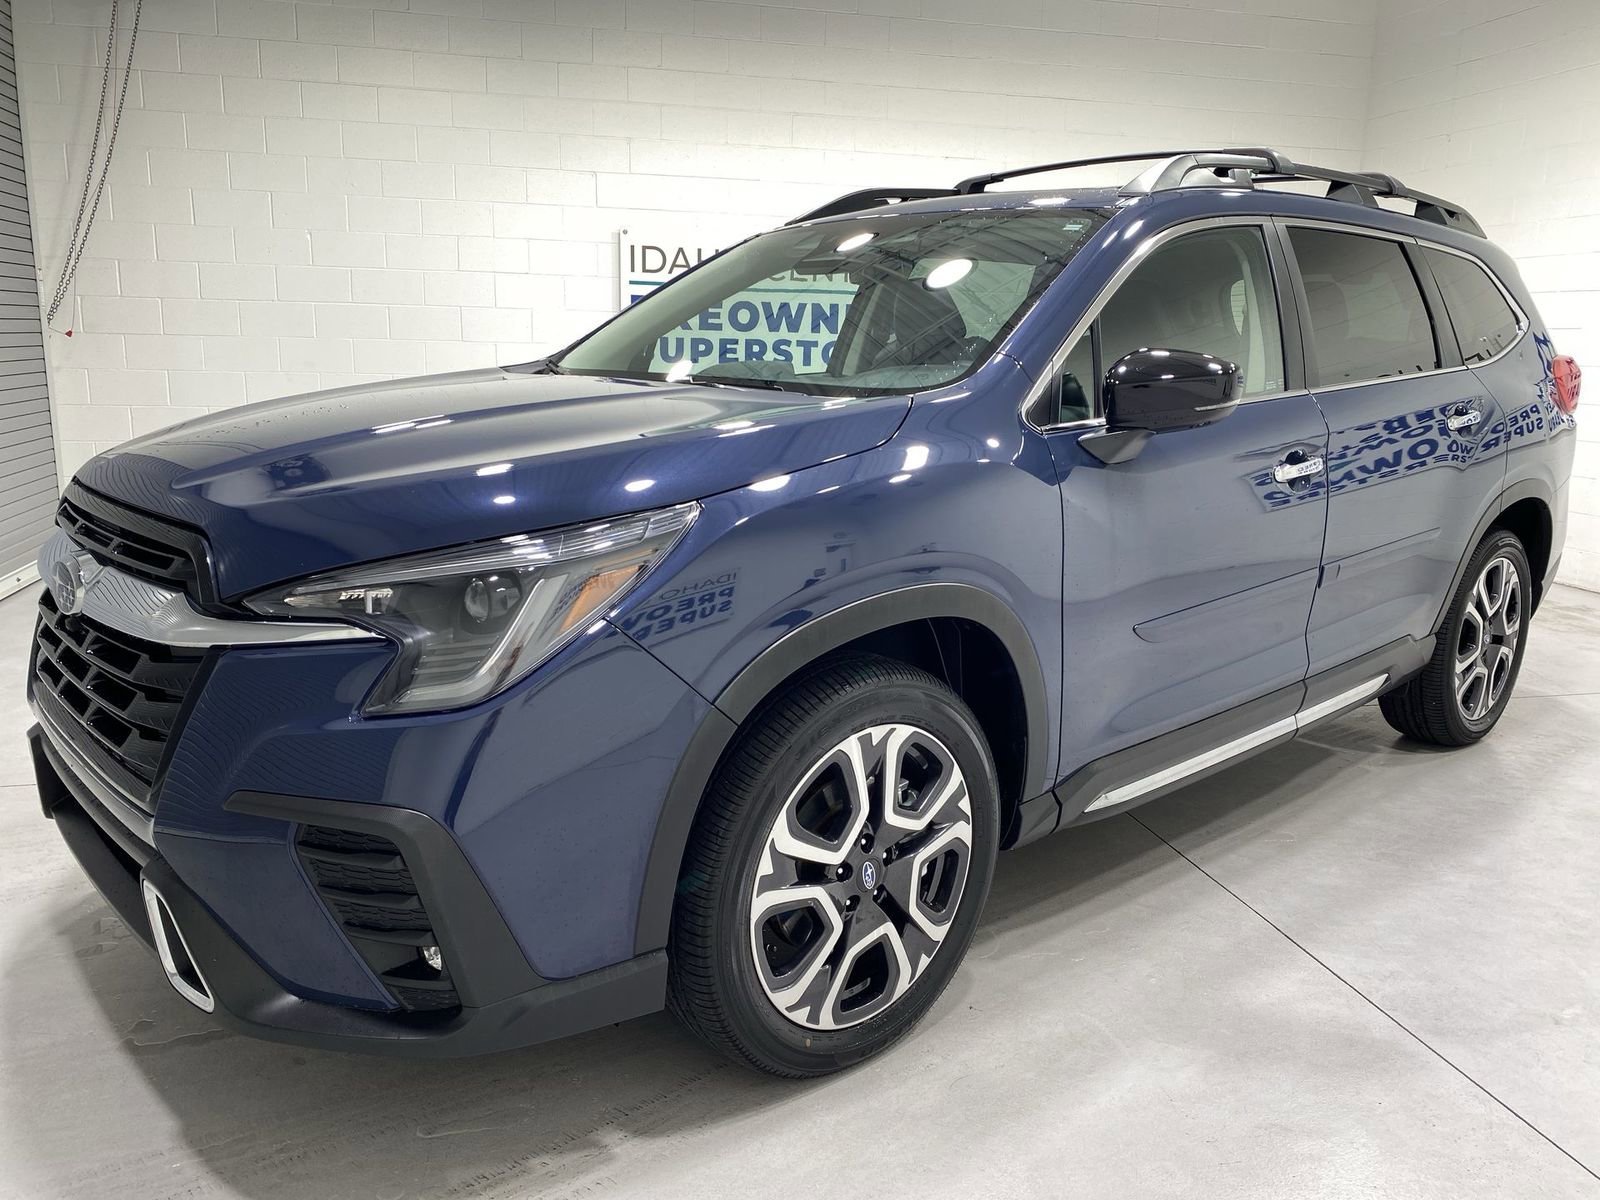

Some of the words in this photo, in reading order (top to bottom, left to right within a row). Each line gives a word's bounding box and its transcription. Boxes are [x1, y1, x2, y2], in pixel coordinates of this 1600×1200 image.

[630, 245, 719, 274] IDA
[674, 300, 852, 334] EOWN
[659, 336, 837, 367] UPERST
